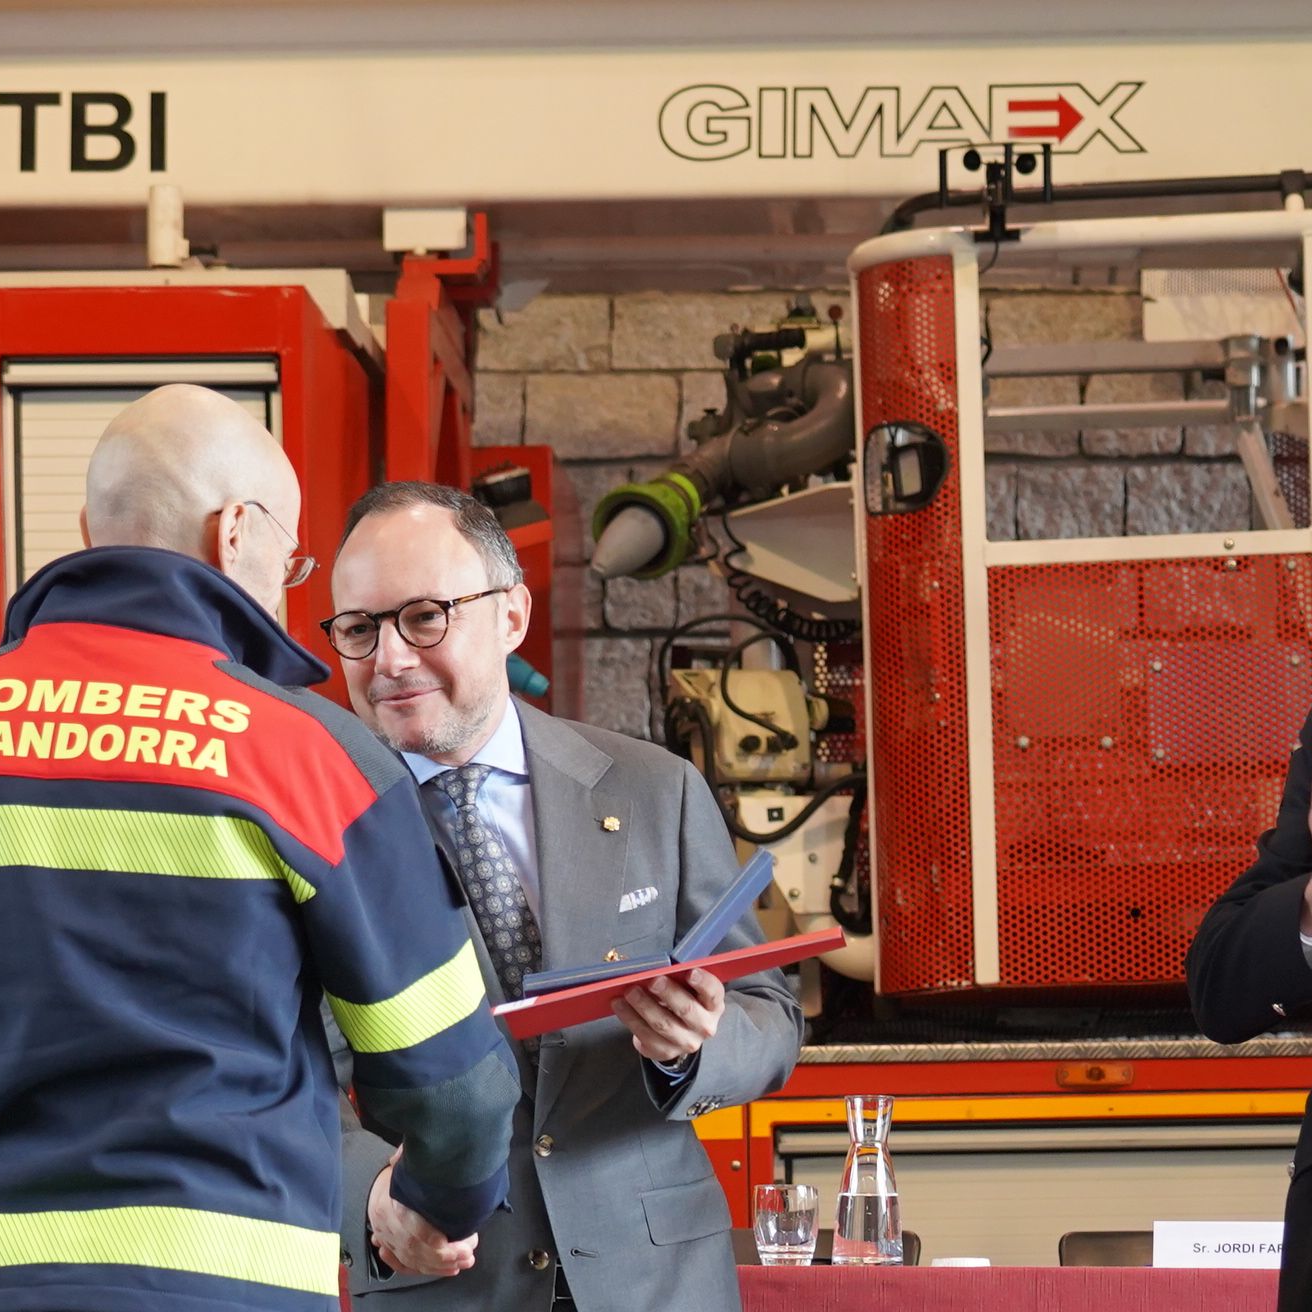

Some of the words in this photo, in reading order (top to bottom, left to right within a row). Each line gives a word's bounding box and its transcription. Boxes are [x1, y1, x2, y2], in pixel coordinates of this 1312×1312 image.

[658, 81, 1148, 161] GIMAEX
[1192, 1242, 1210, 1254] Sr.
[1214, 1242, 1255, 1254] JORDI
